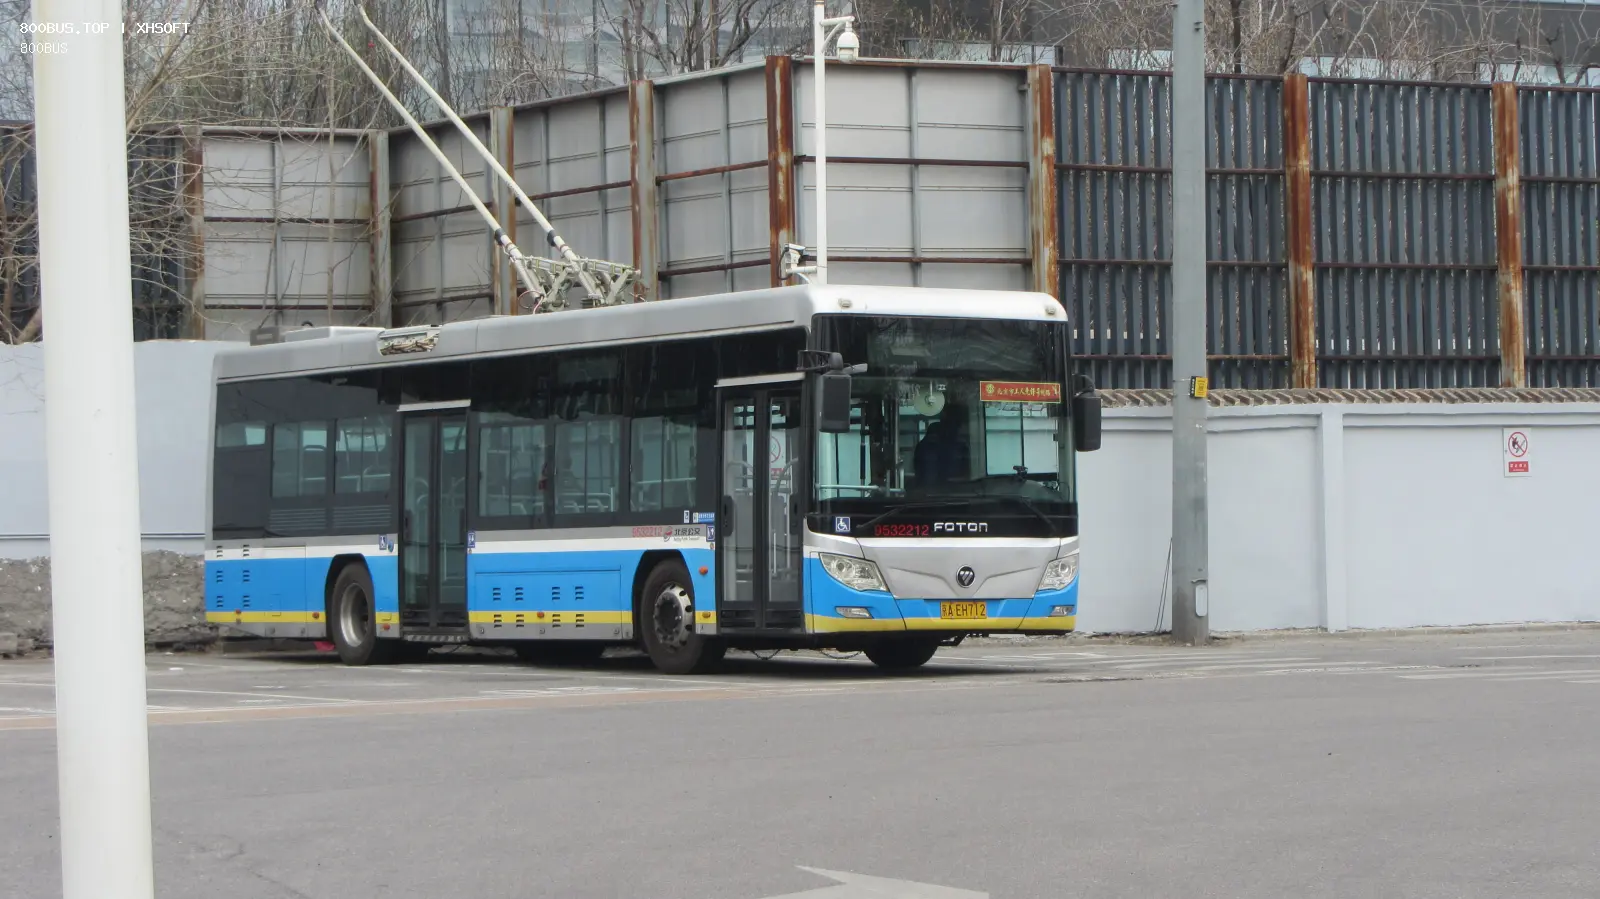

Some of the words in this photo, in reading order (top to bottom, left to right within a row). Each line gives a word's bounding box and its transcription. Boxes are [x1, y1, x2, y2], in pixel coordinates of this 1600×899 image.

[674, 527, 701, 536] 北京公交
[933, 522, 988, 532] FOTON
